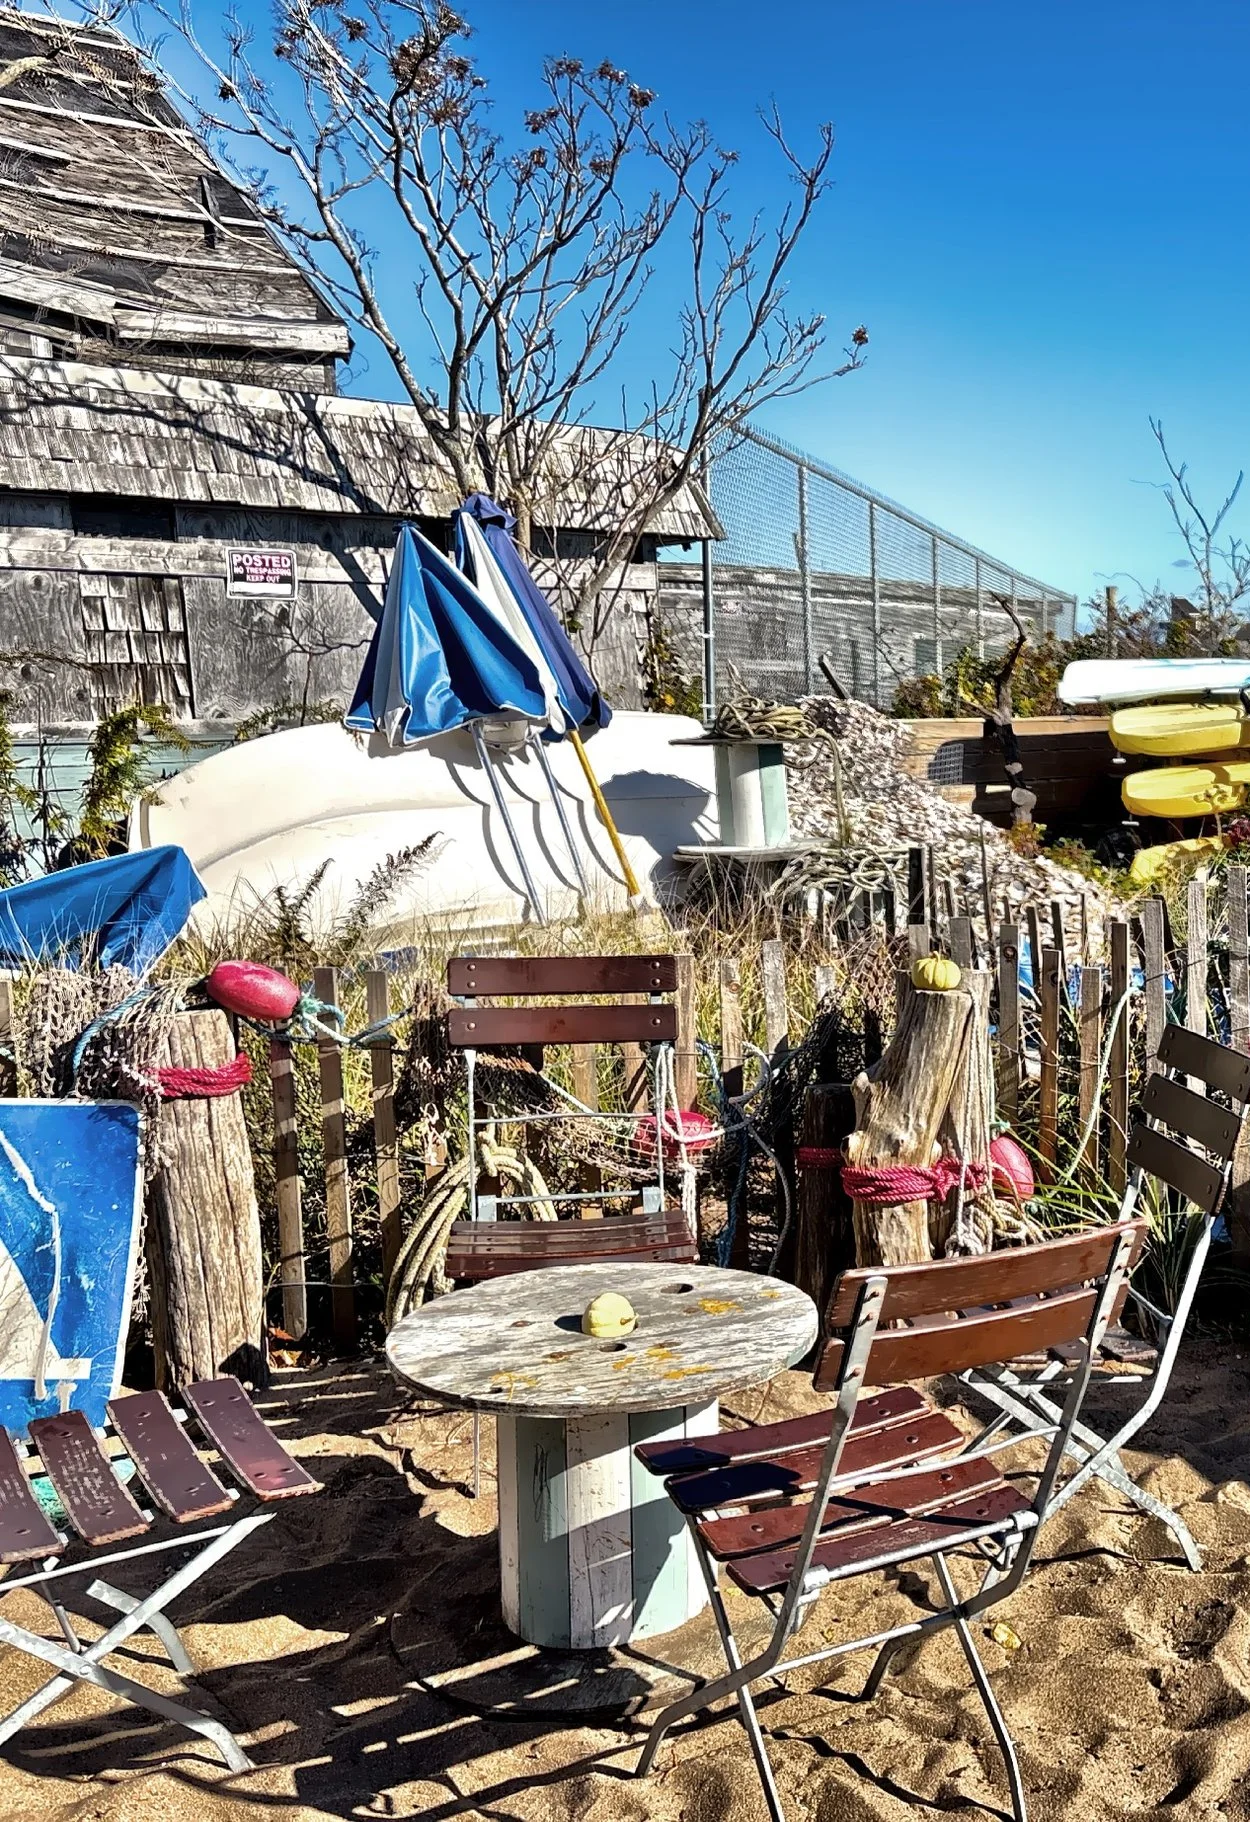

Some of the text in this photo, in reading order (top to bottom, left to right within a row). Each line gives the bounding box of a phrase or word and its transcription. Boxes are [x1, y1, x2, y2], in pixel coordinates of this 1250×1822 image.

[232, 554, 291, 568] POSTED
[234, 566, 291, 576] NO TRESPASSING
[266, 575, 280, 583] OUT
